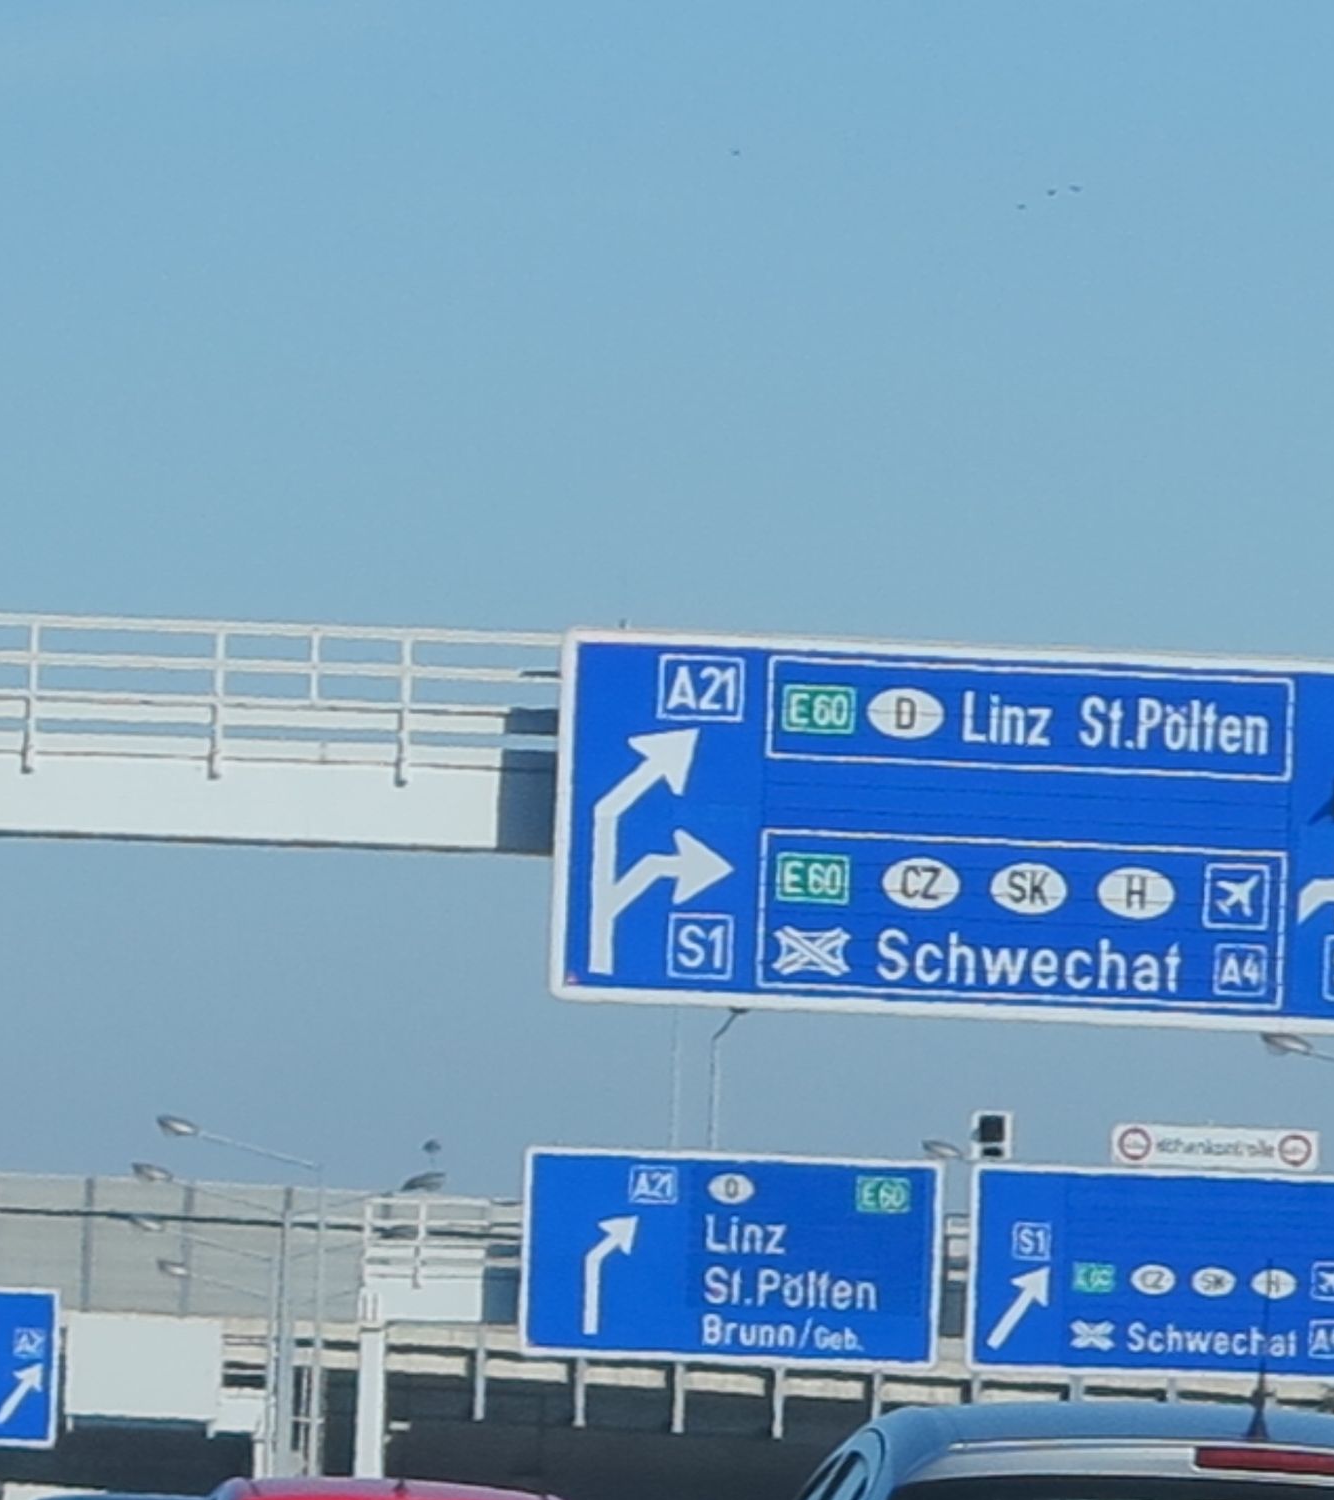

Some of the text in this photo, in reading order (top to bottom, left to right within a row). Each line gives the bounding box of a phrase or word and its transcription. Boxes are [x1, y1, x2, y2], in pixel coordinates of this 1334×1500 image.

[668, 665, 736, 712] A21
[788, 694, 850, 727] E60
[895, 697, 916, 730] D
[962, 690, 1269, 756] Linz St.Pölten
[783, 862, 841, 896] E60
[900, 867, 942, 901] CZ
[1007, 872, 1050, 906] SK
[1126, 876, 1146, 910] H
[677, 925, 725, 969] S1
[876, 928, 1182, 992] Schwechat
[1220, 957, 1261, 987] A4
[632, 1171, 674, 1201] A21
[861, 1180, 906, 1209] E60
[705, 1214, 788, 1256] Linz
[1019, 1229, 1046, 1256] S1
[1140, 1270, 1166, 1291] CZ
[1201, 1273, 1225, 1292] SK
[1126, 1321, 1297, 1358] Schwechat
